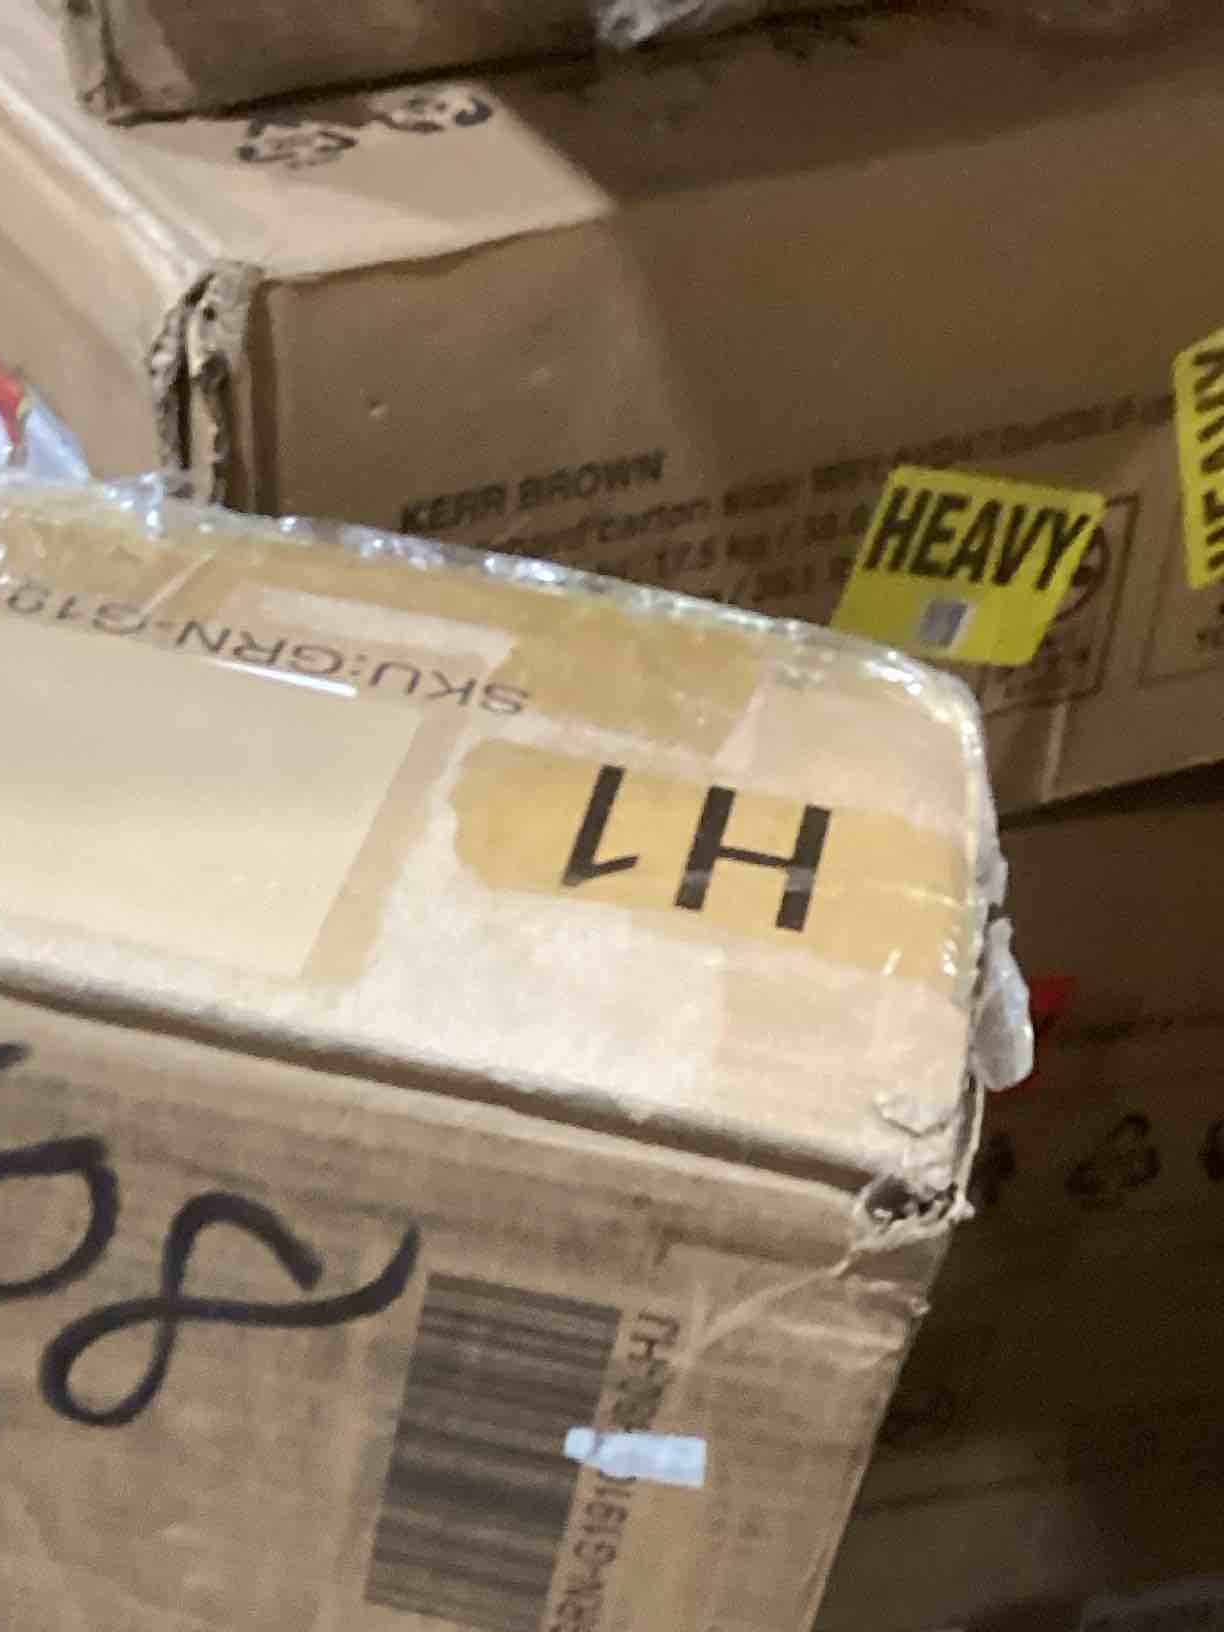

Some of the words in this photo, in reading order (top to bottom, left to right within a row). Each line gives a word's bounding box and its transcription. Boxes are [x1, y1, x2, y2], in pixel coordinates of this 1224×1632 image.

[518, 448, 665, 509] BROWN
[866, 486, 1088, 593] HEAVY
[562, 763, 832, 933] H1
